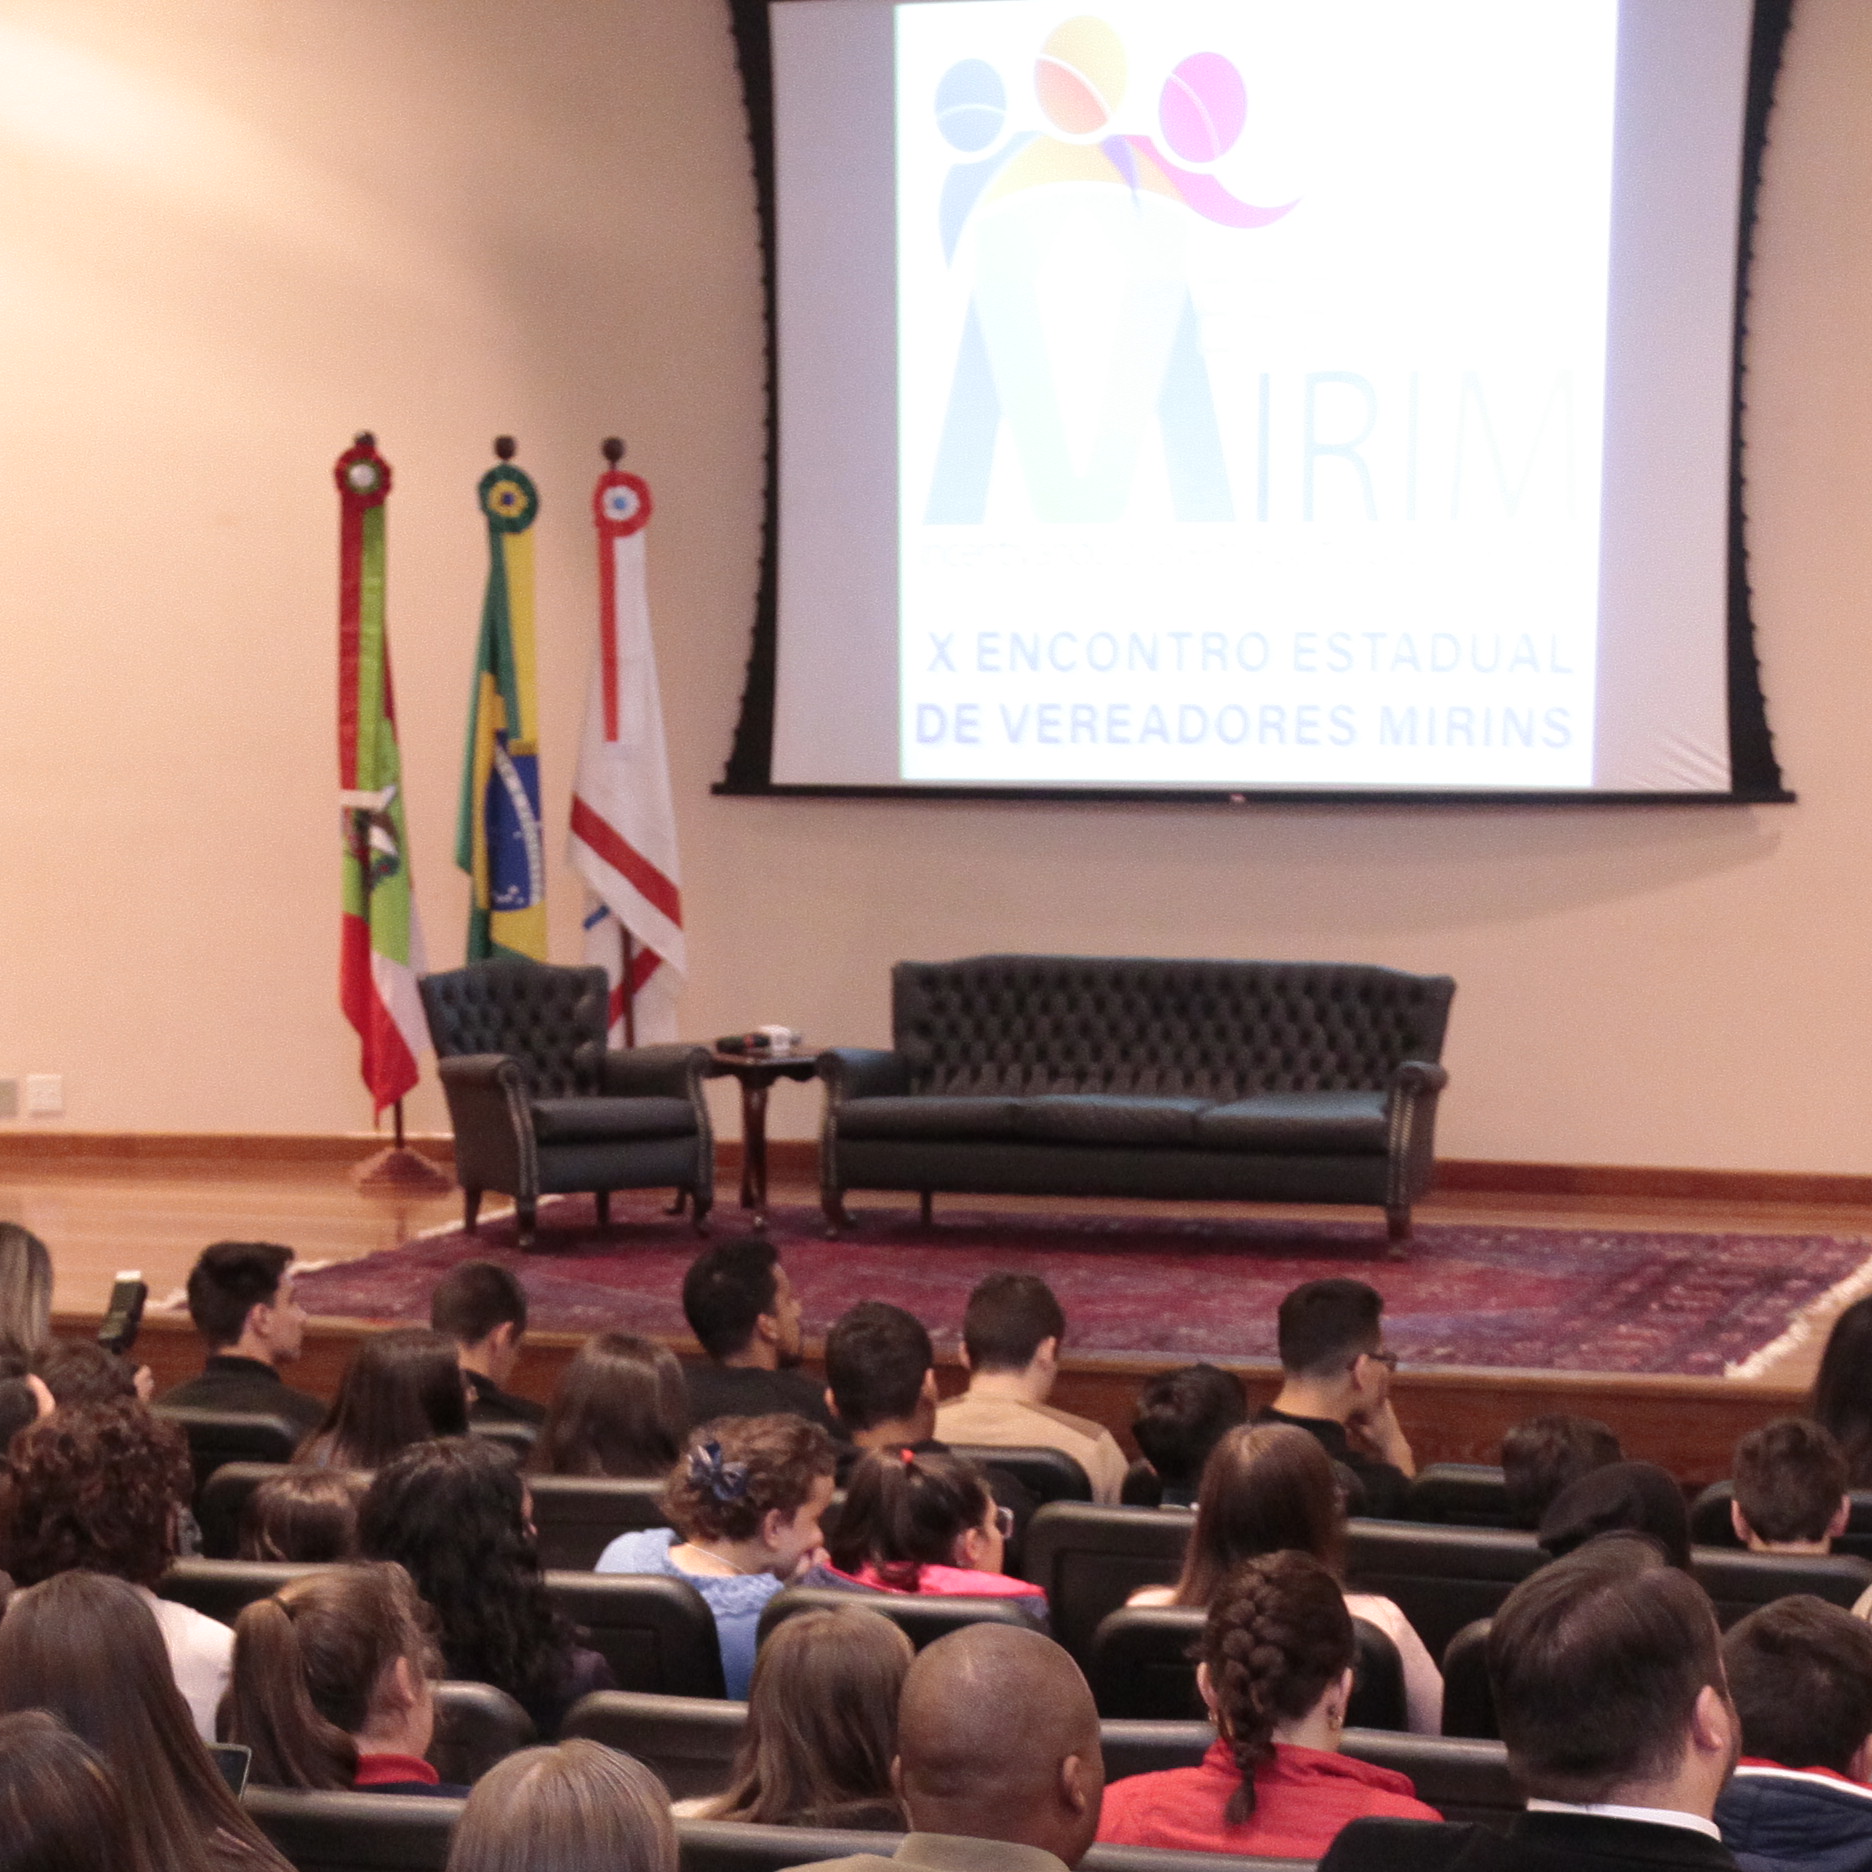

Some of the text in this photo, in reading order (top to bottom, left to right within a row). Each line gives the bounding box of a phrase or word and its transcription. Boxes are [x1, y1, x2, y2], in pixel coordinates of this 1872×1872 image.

[927, 630, 1575, 675] X ENCONTRO ESTADUAL
[915, 702, 1575, 750] DE VEREADORES MIRINS
